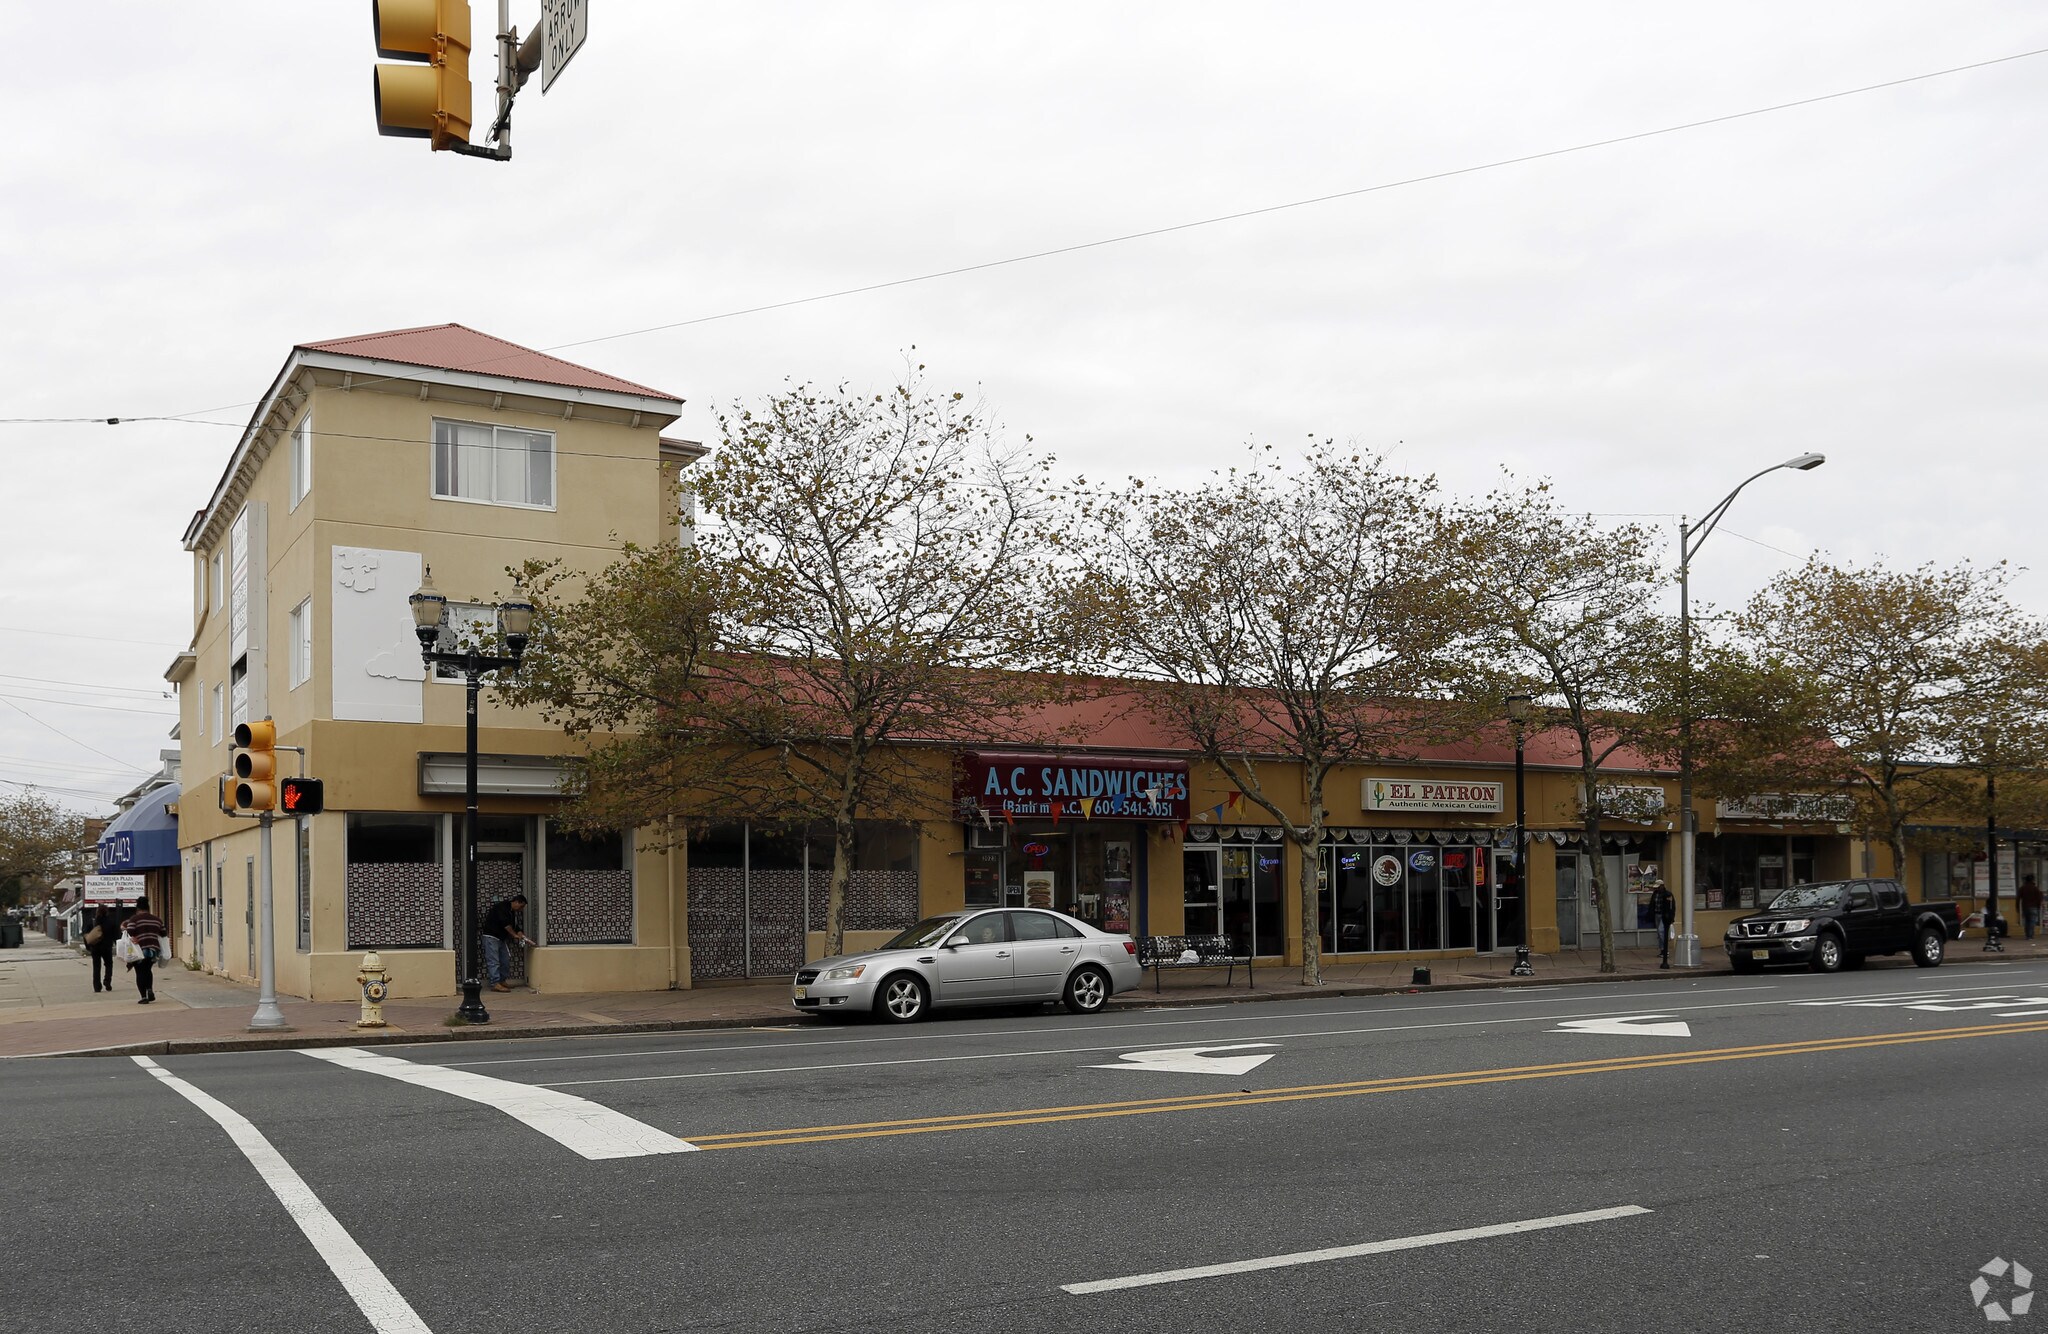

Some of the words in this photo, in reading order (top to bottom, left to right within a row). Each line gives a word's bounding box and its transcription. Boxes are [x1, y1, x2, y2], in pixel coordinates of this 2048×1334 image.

[551, 18, 576, 71] ONLY
[984, 766, 1033, 796] A.C.
[1041, 767, 1186, 800] SANDWICHES
[1390, 784, 1416, 799] EL
[1421, 785, 1496, 801] PATRON
[1432, 801, 1466, 809] Mexican
[1468, 802, 1497, 810] Cuisine
